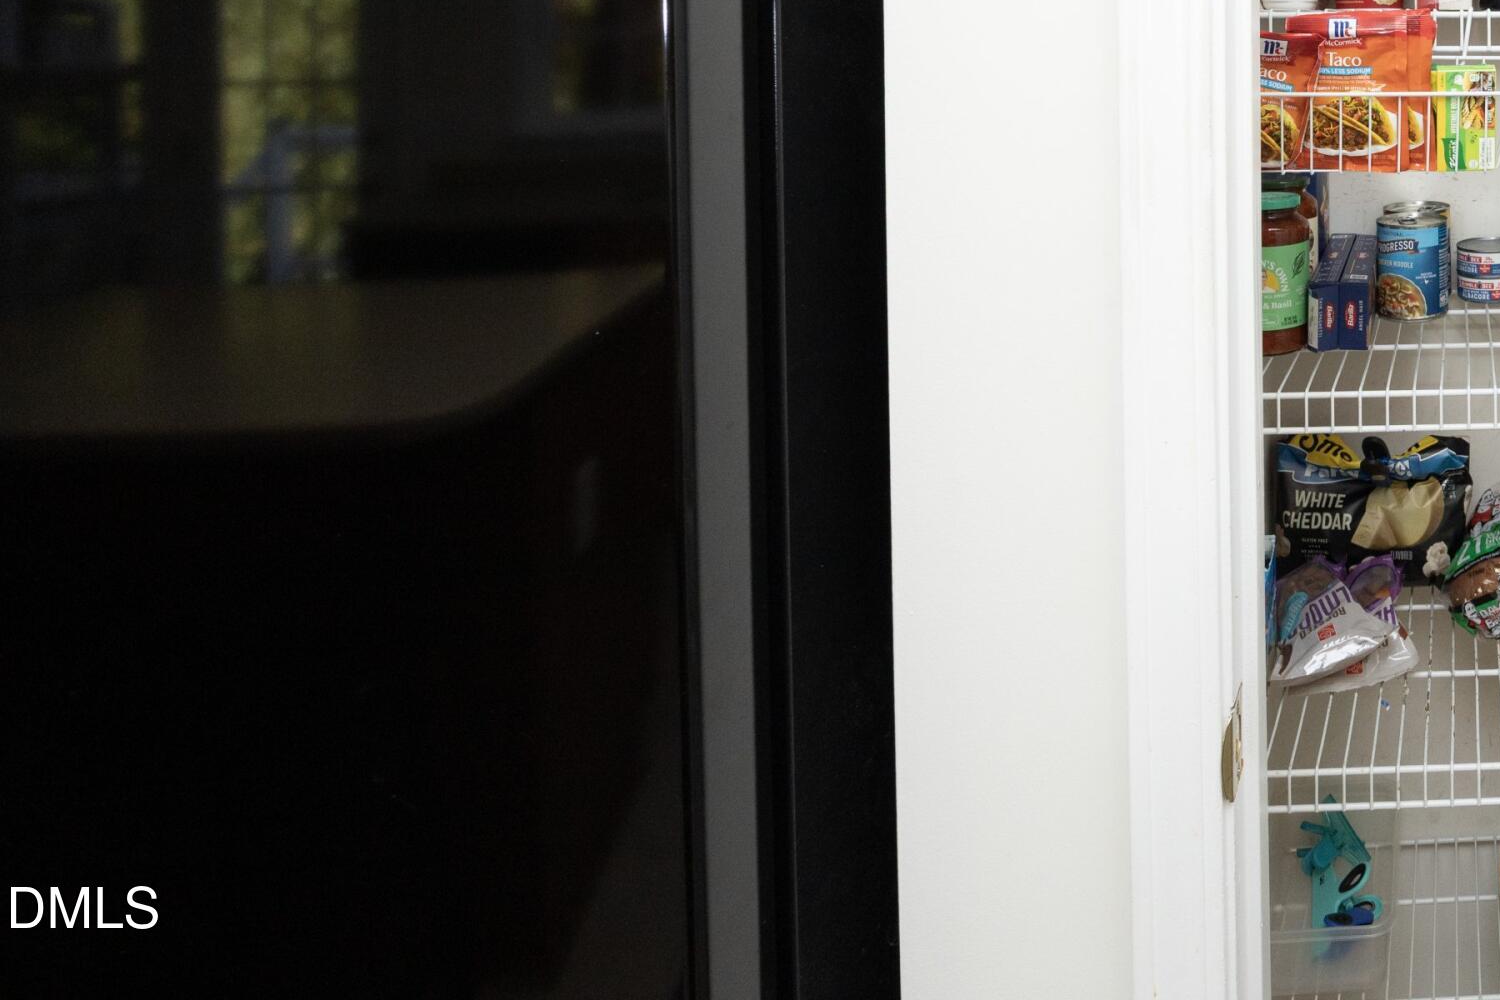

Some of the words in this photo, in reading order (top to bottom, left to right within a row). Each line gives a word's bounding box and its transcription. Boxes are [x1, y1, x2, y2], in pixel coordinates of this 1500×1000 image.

[1323, 39, 1362, 47] McCormick
[1325, 51, 1362, 67] Taco
[1347, 67, 1372, 75] SODIUM
[1269, 80, 1294, 92] SODIUM
[1271, 299, 1293, 309] Basil
[1295, 489, 1346, 509] WHITE
[1282, 510, 1353, 531] CHEDDAR
